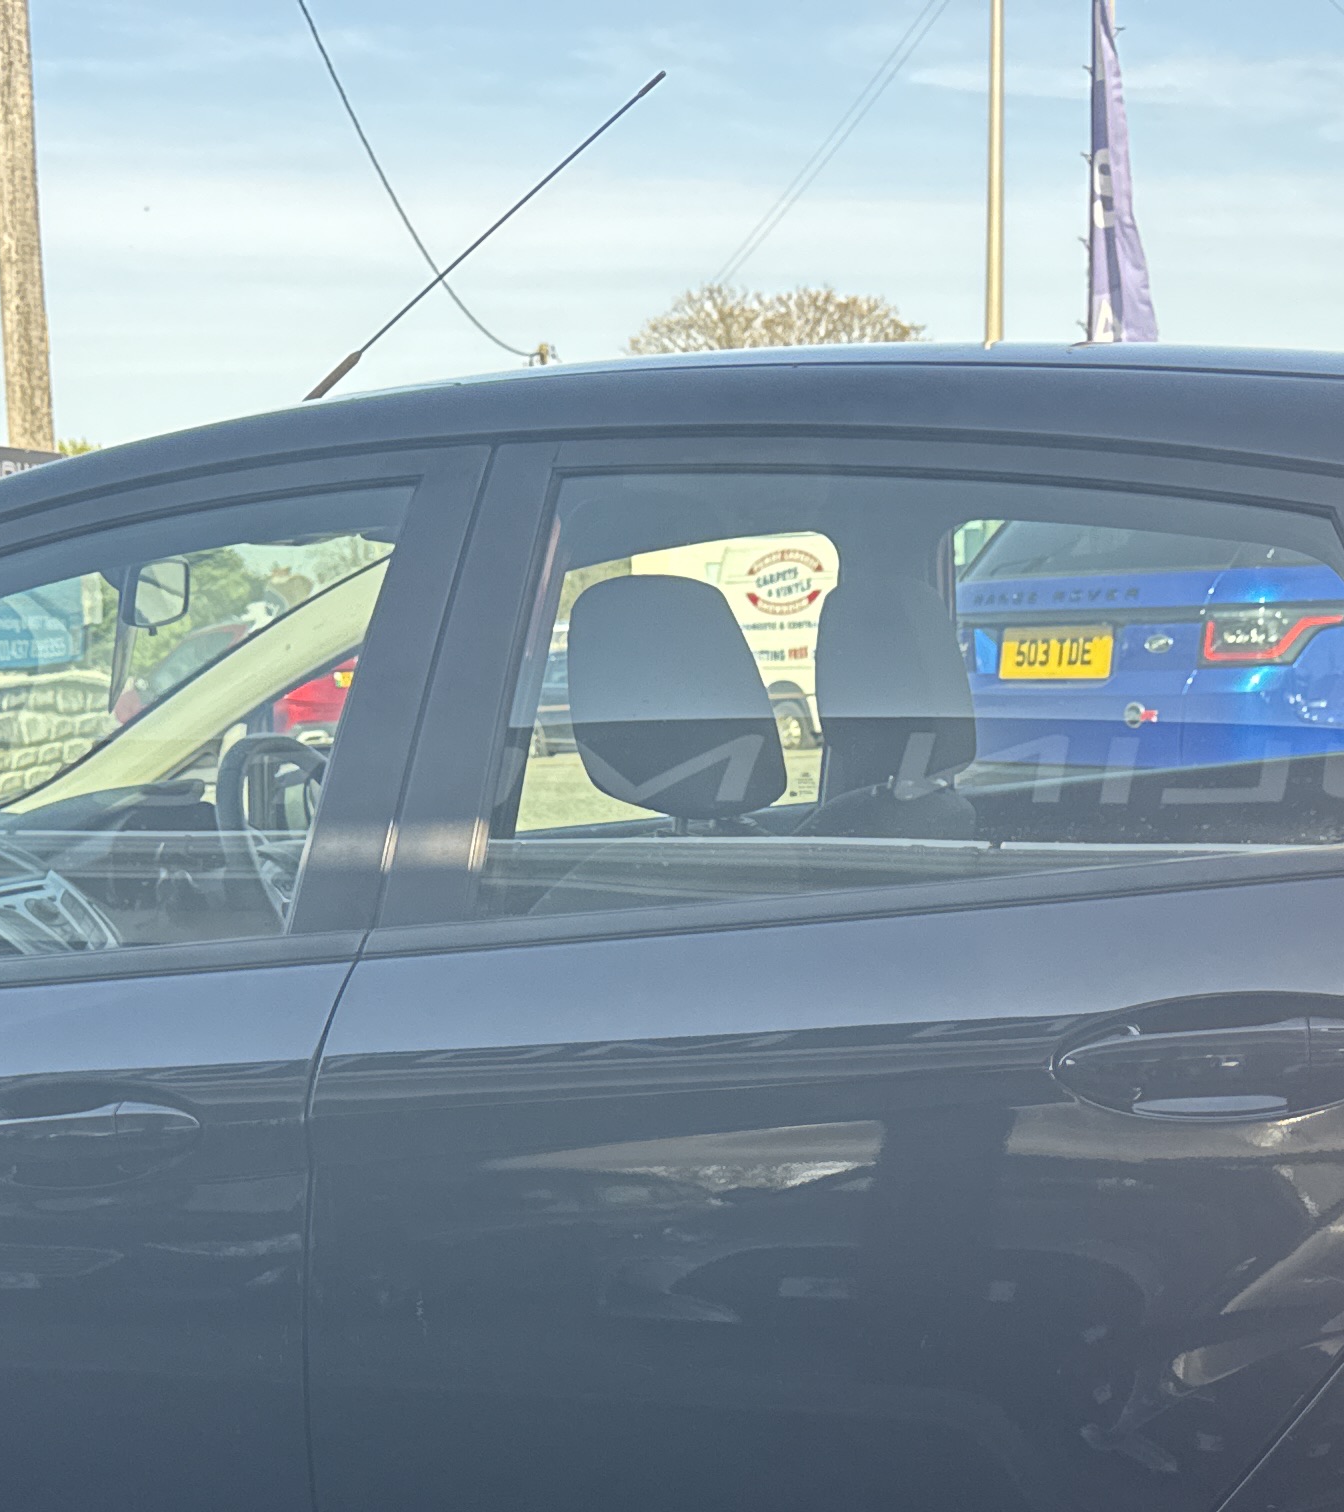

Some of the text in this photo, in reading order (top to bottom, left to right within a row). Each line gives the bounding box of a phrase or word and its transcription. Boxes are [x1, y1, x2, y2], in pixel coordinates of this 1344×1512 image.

[755, 566, 799, 589] CARPETS
[973, 586, 1141, 606] RANGE ROVER
[1057, 637, 1093, 667] TDE
